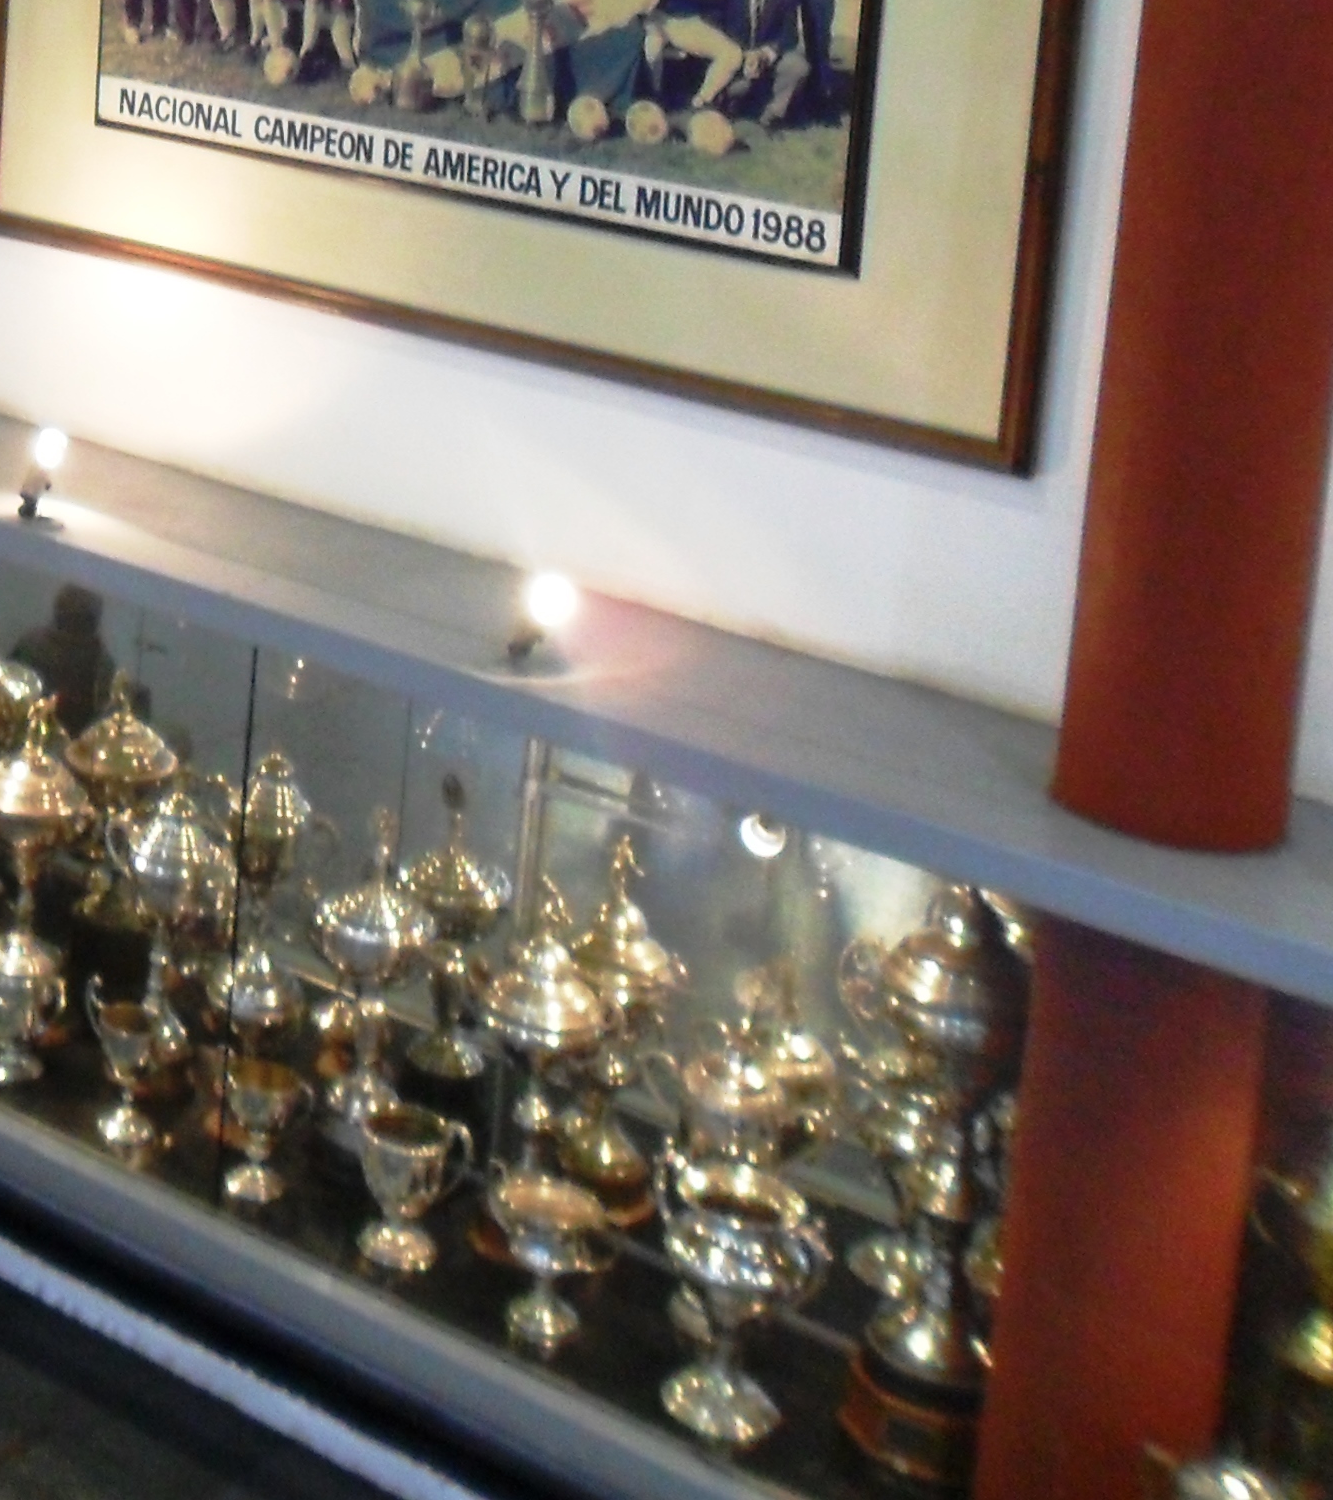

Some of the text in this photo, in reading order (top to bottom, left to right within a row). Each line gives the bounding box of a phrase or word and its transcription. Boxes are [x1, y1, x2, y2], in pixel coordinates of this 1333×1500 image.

[118, 87, 828, 255] NACIONAL CAMPEON DE AMERICA Y DEL MUNDO 1988
